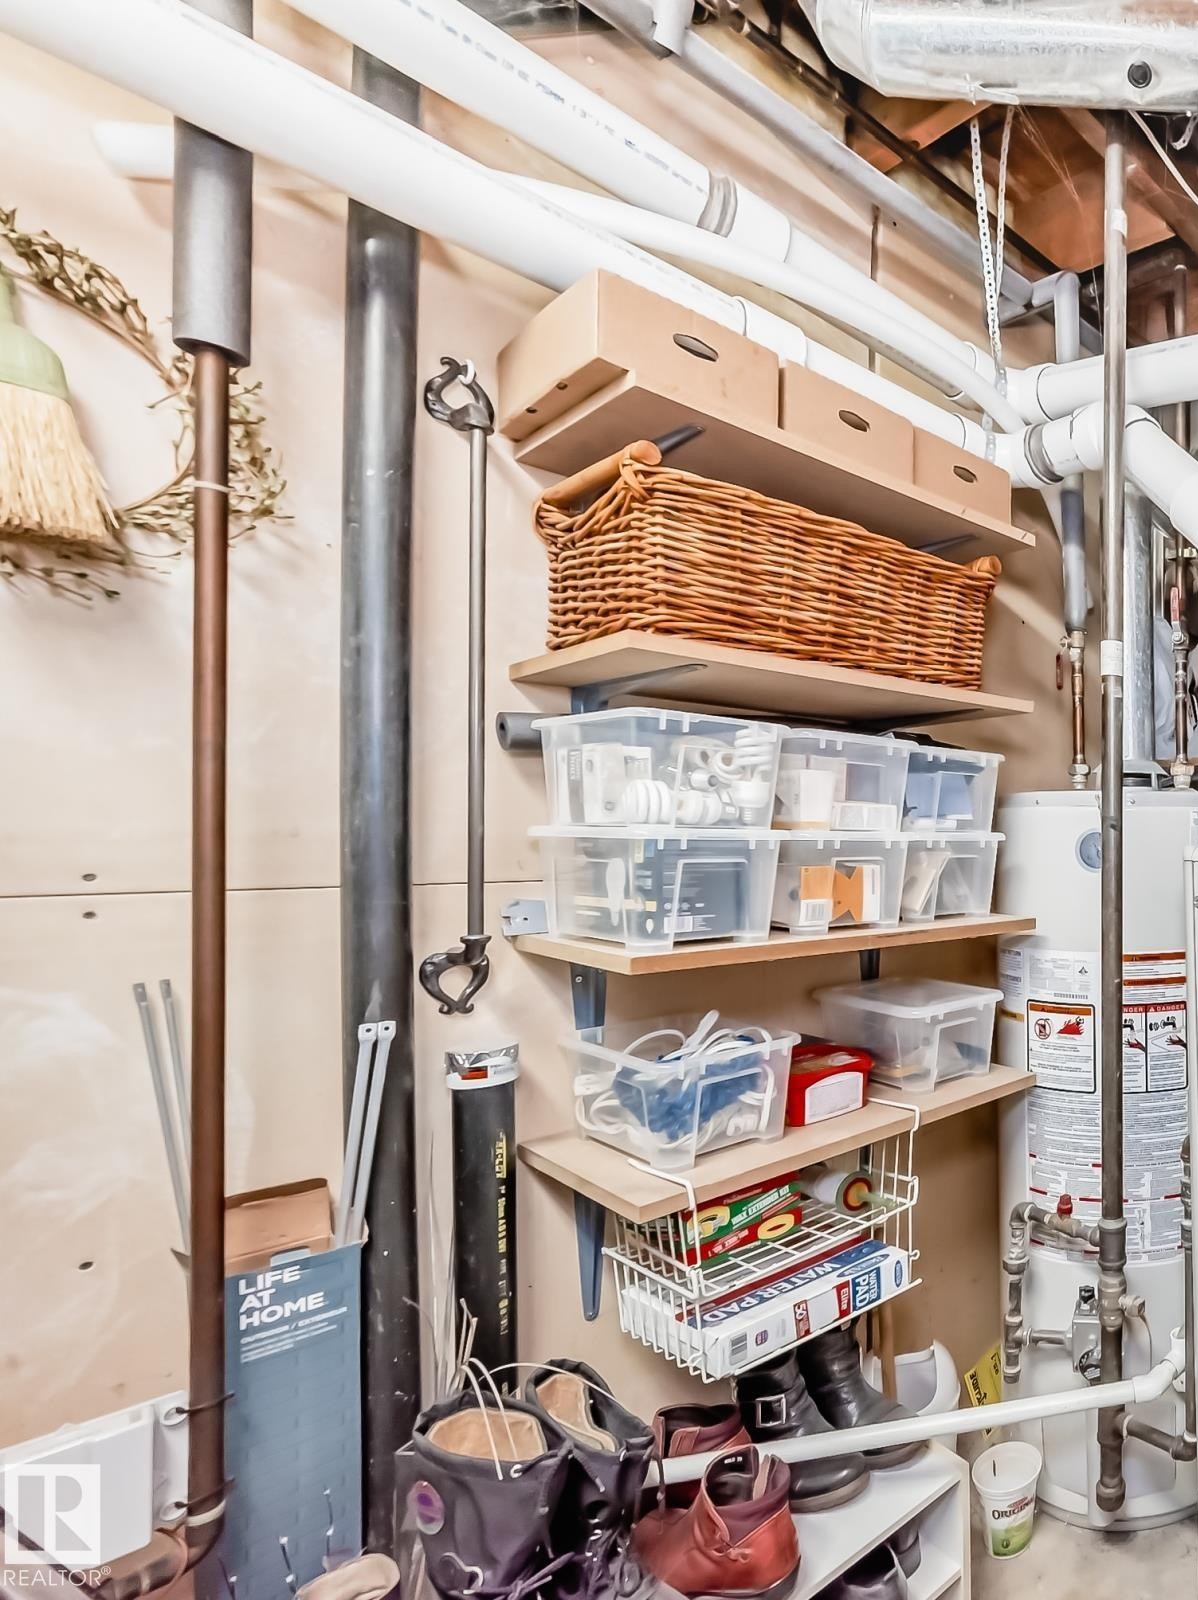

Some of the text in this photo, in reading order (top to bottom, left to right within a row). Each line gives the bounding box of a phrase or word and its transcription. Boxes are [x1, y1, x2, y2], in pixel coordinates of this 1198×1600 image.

[1157, 1003, 1185, 1011] DANGER
[239, 1265, 301, 1295] LIFE
[756, 1262, 840, 1298] WATER
[854, 1274, 868, 1309] PAD
[868, 1268, 880, 1300] WATER
[239, 1288, 276, 1312] AT
[239, 1291, 326, 1331] HOME
[702, 1296, 760, 1323] PAD
[840, 1287, 849, 1310] Elite
